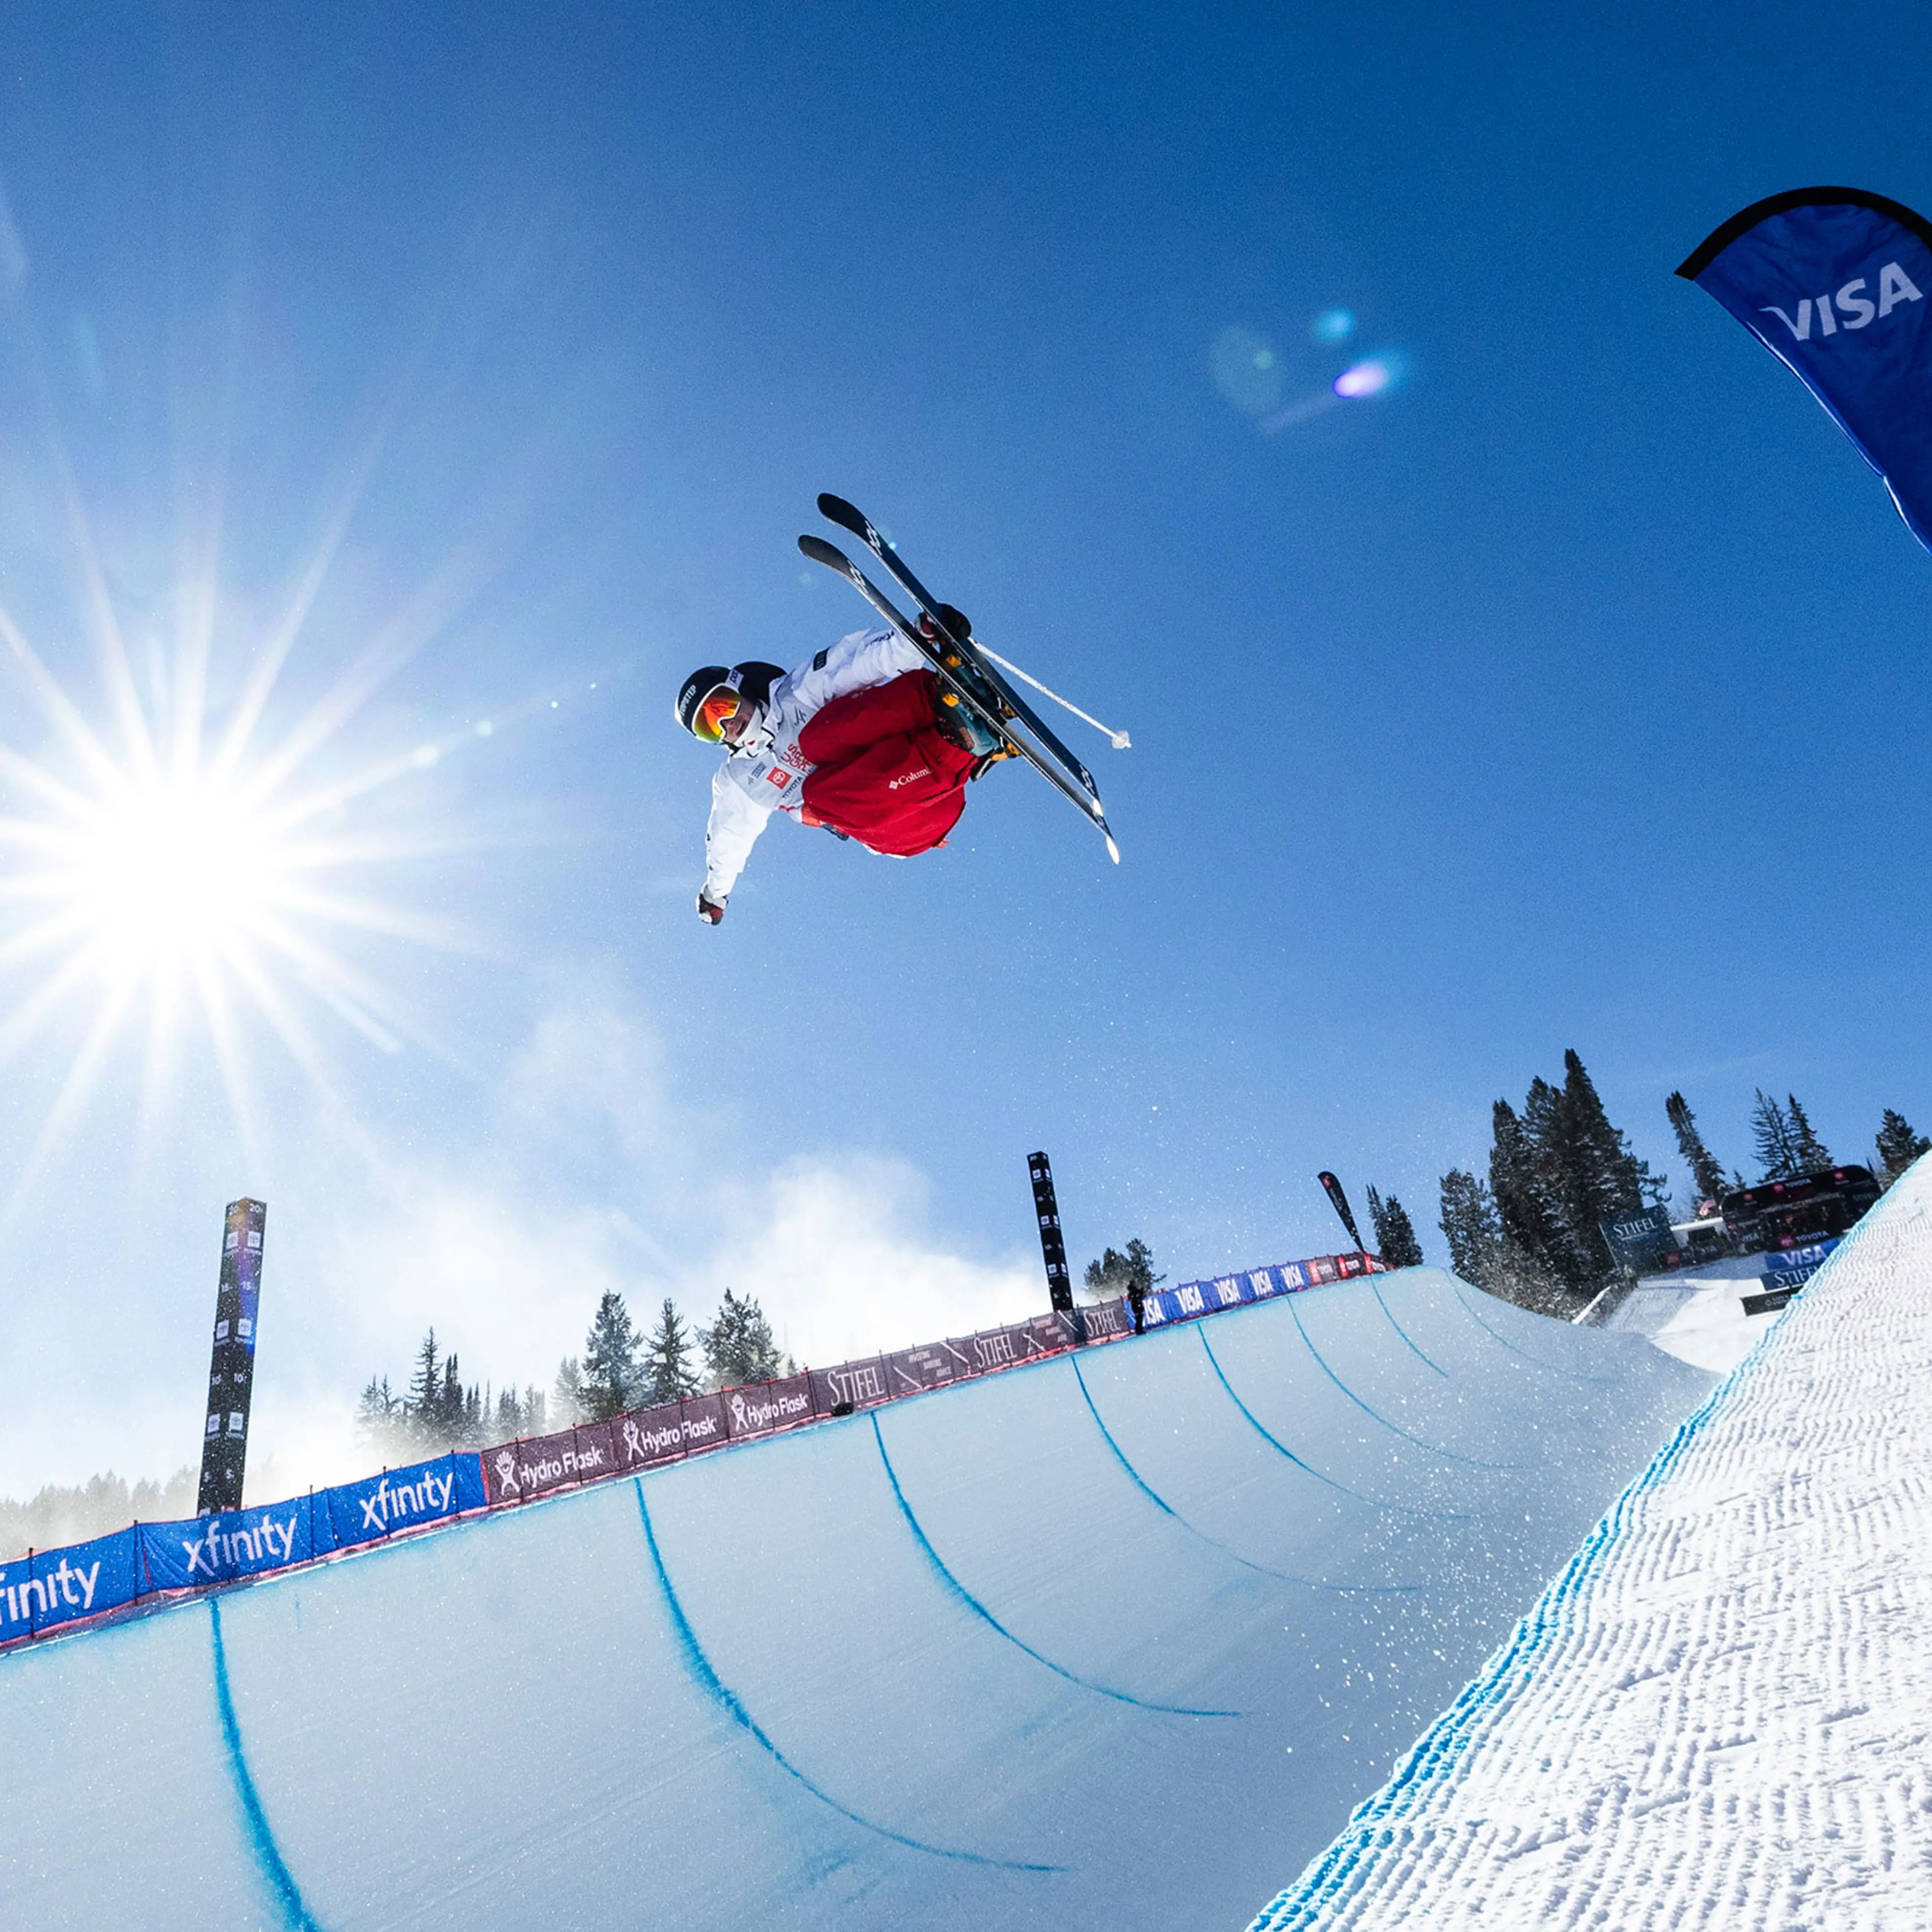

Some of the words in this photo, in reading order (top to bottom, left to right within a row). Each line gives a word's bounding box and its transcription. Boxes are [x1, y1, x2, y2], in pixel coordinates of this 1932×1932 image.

[1759, 262, 1923, 341] VISA
[782, 776, 803, 799] TOYOTA
[1613, 1217, 1657, 1238] STIFEL
[1796, 1230, 1829, 1242] TOYOTA
[1781, 1245, 1827, 1266] VISA
[1248, 1270, 1274, 1296] VISA
[1280, 1264, 1305, 1290] VISA
[1774, 1266, 1818, 1286] STIFE
[1174, 1285, 1204, 1314] VISA
[1214, 1278, 1241, 1306] VISA
[1083, 1308, 1121, 1337] STIFEL
[1142, 1298, 1166, 1327] ISA
[974, 1333, 1018, 1369] STIFEL
[828, 1367, 884, 1407] STIFEL
[747, 1403, 780, 1427] Hydro
[778, 1394, 809, 1415] Flask
[640, 1427, 681, 1453] Hydro
[681, 1416, 716, 1440] Flask
[519, 1457, 563, 1488] Hydro
[562, 1445, 602, 1475] Flask
[358, 1471, 453, 1531] xfinity
[182, 1514, 297, 1577] xfinity
